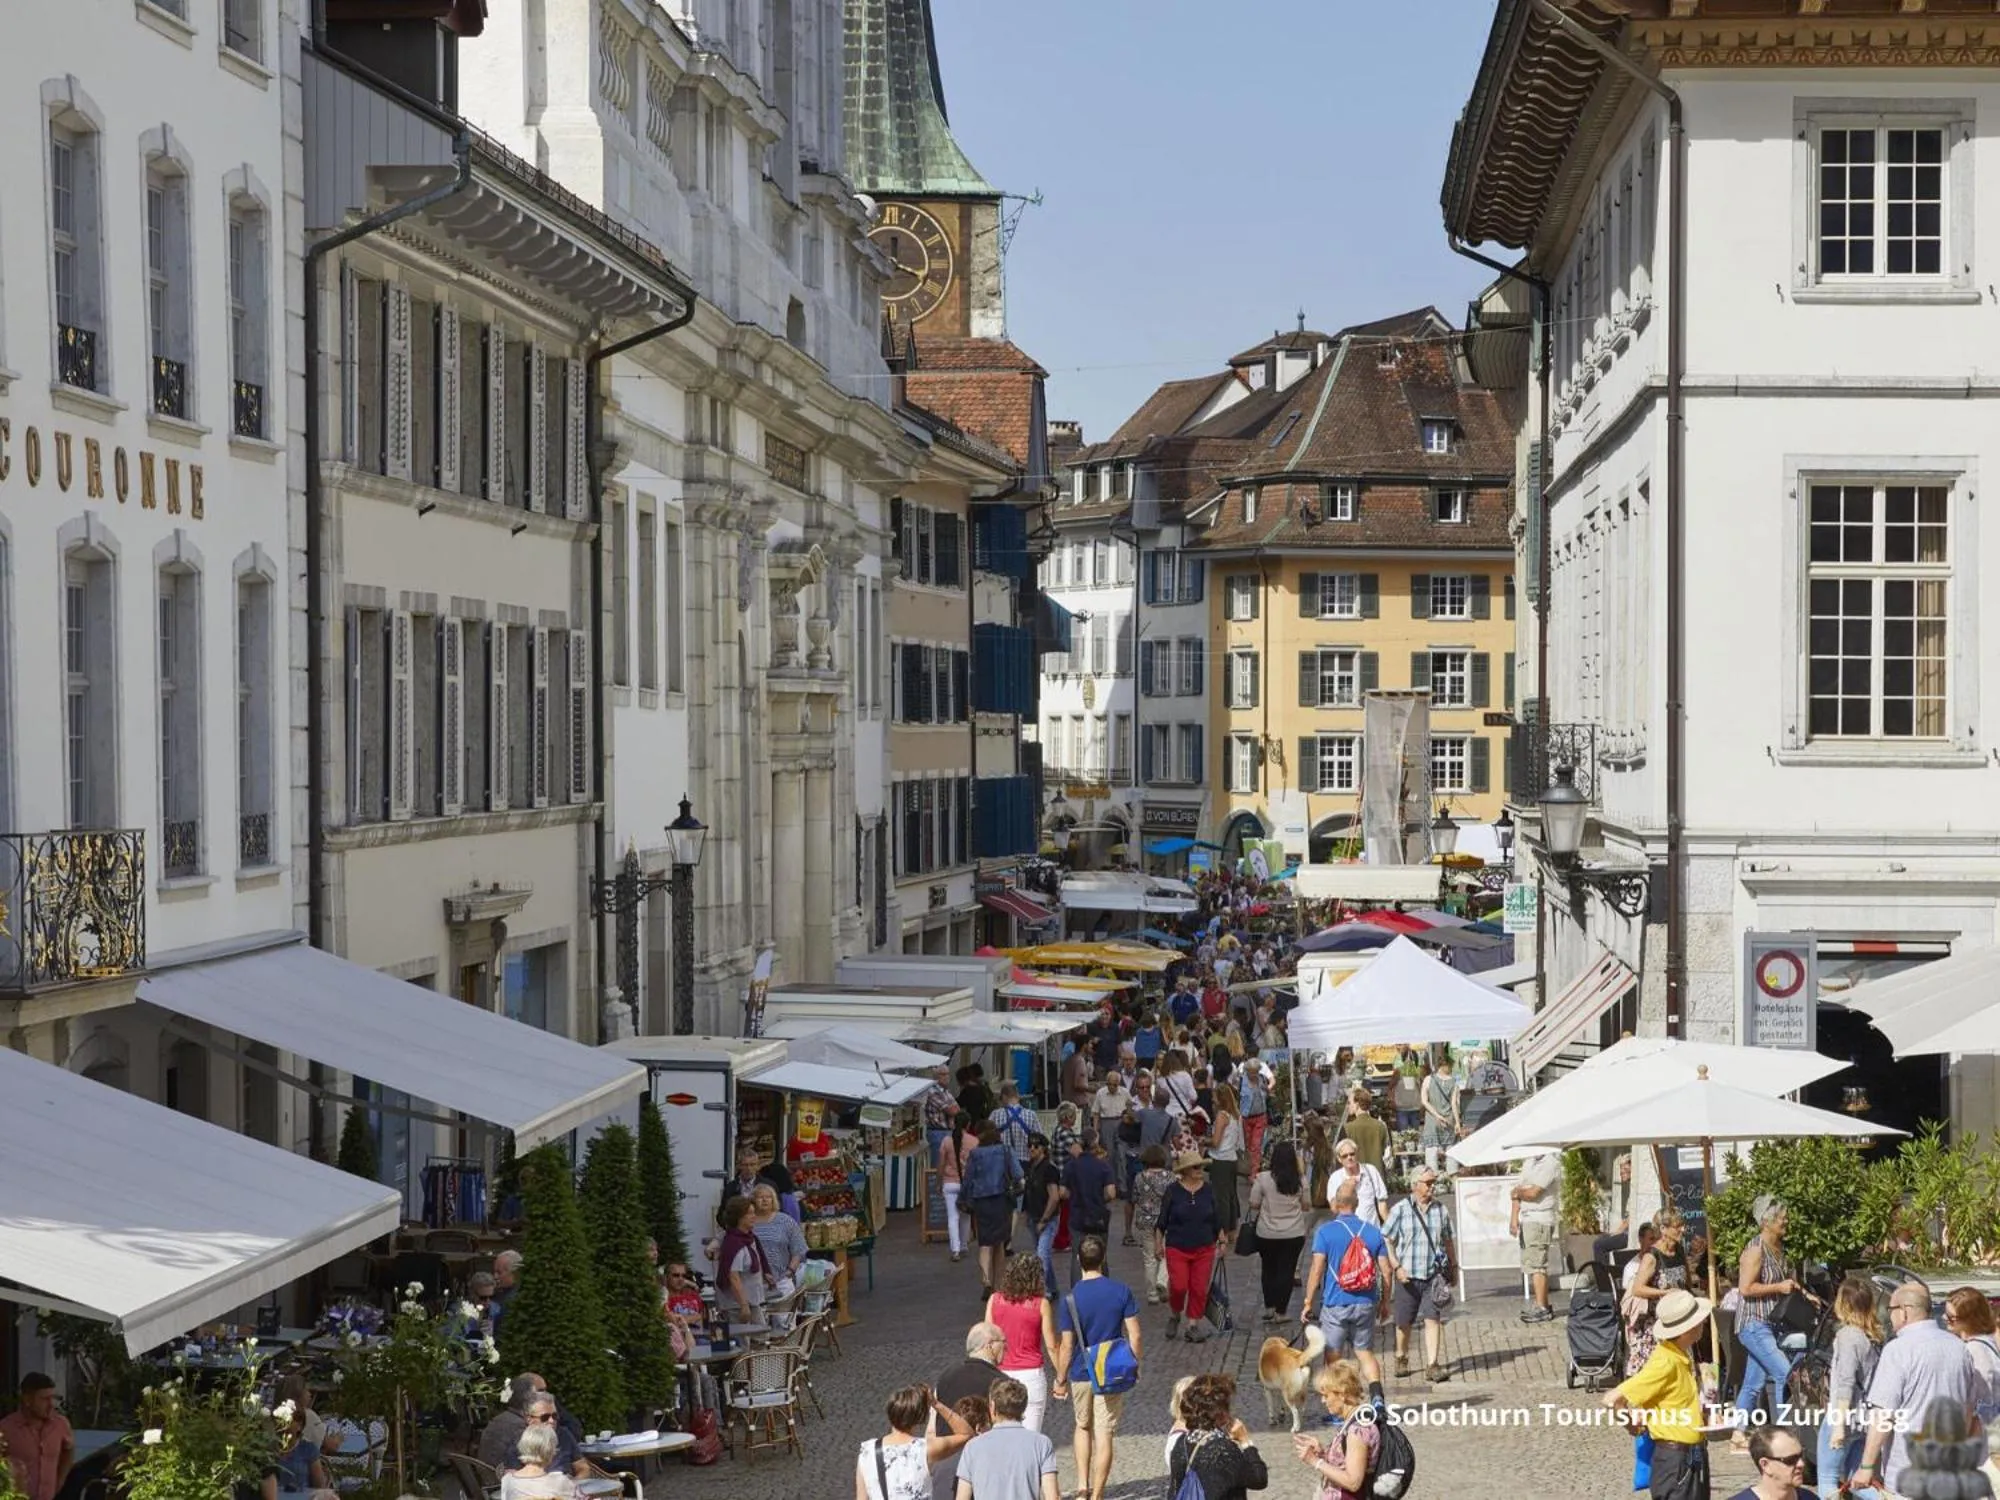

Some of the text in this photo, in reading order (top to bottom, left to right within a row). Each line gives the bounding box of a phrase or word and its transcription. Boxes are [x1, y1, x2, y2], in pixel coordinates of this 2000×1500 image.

[0, 417, 204, 519] COURONNE
[1754, 1004, 1803, 1014] Hotelgäste
[1754, 1018, 1803, 1028] mit Gepäck
[1759, 1031, 1802, 1040] gestattet
